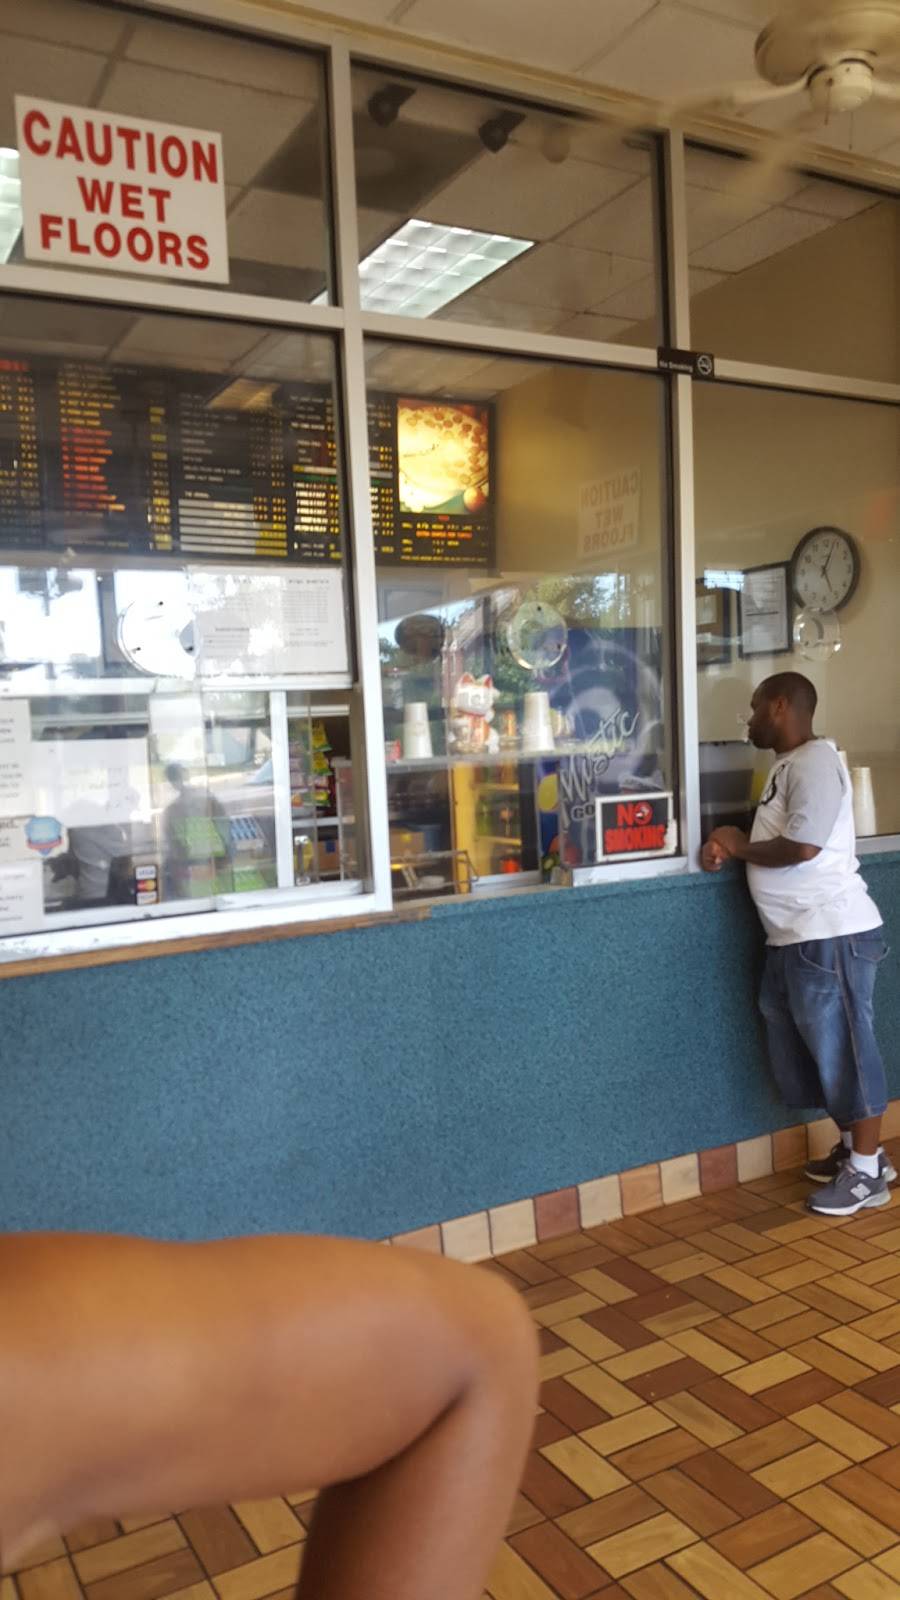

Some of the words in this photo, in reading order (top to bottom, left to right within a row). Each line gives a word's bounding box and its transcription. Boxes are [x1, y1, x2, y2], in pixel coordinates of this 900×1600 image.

[23, 110, 219, 184] CAUTION
[77, 176, 171, 224] WET
[40, 213, 210, 270] FLOORS
[616, 800, 653, 827] NO
